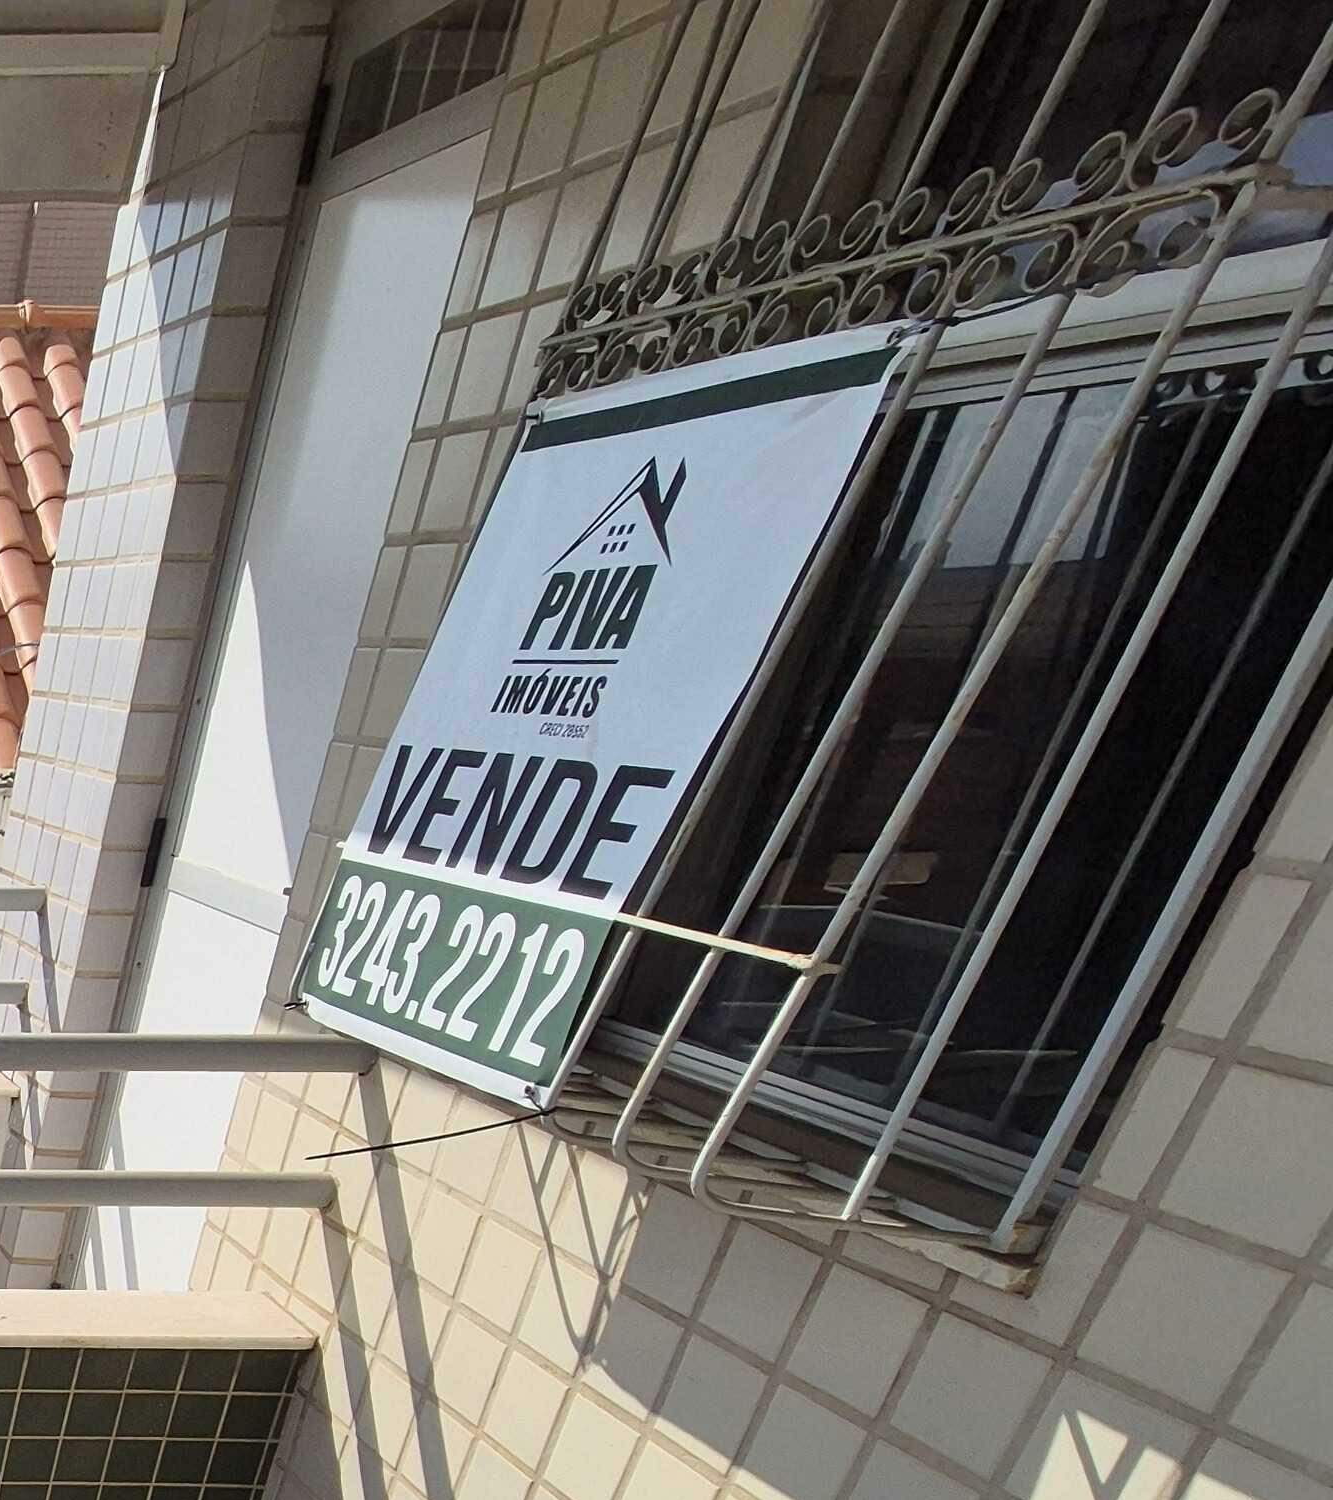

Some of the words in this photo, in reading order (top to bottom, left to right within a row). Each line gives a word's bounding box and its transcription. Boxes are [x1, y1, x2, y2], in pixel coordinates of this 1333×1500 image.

[519, 565, 658, 650] PIVA
[491, 668, 607, 718] IMÓVEIS
[367, 744, 676, 901] VENDE
[318, 875, 584, 1068] 3243.2212
